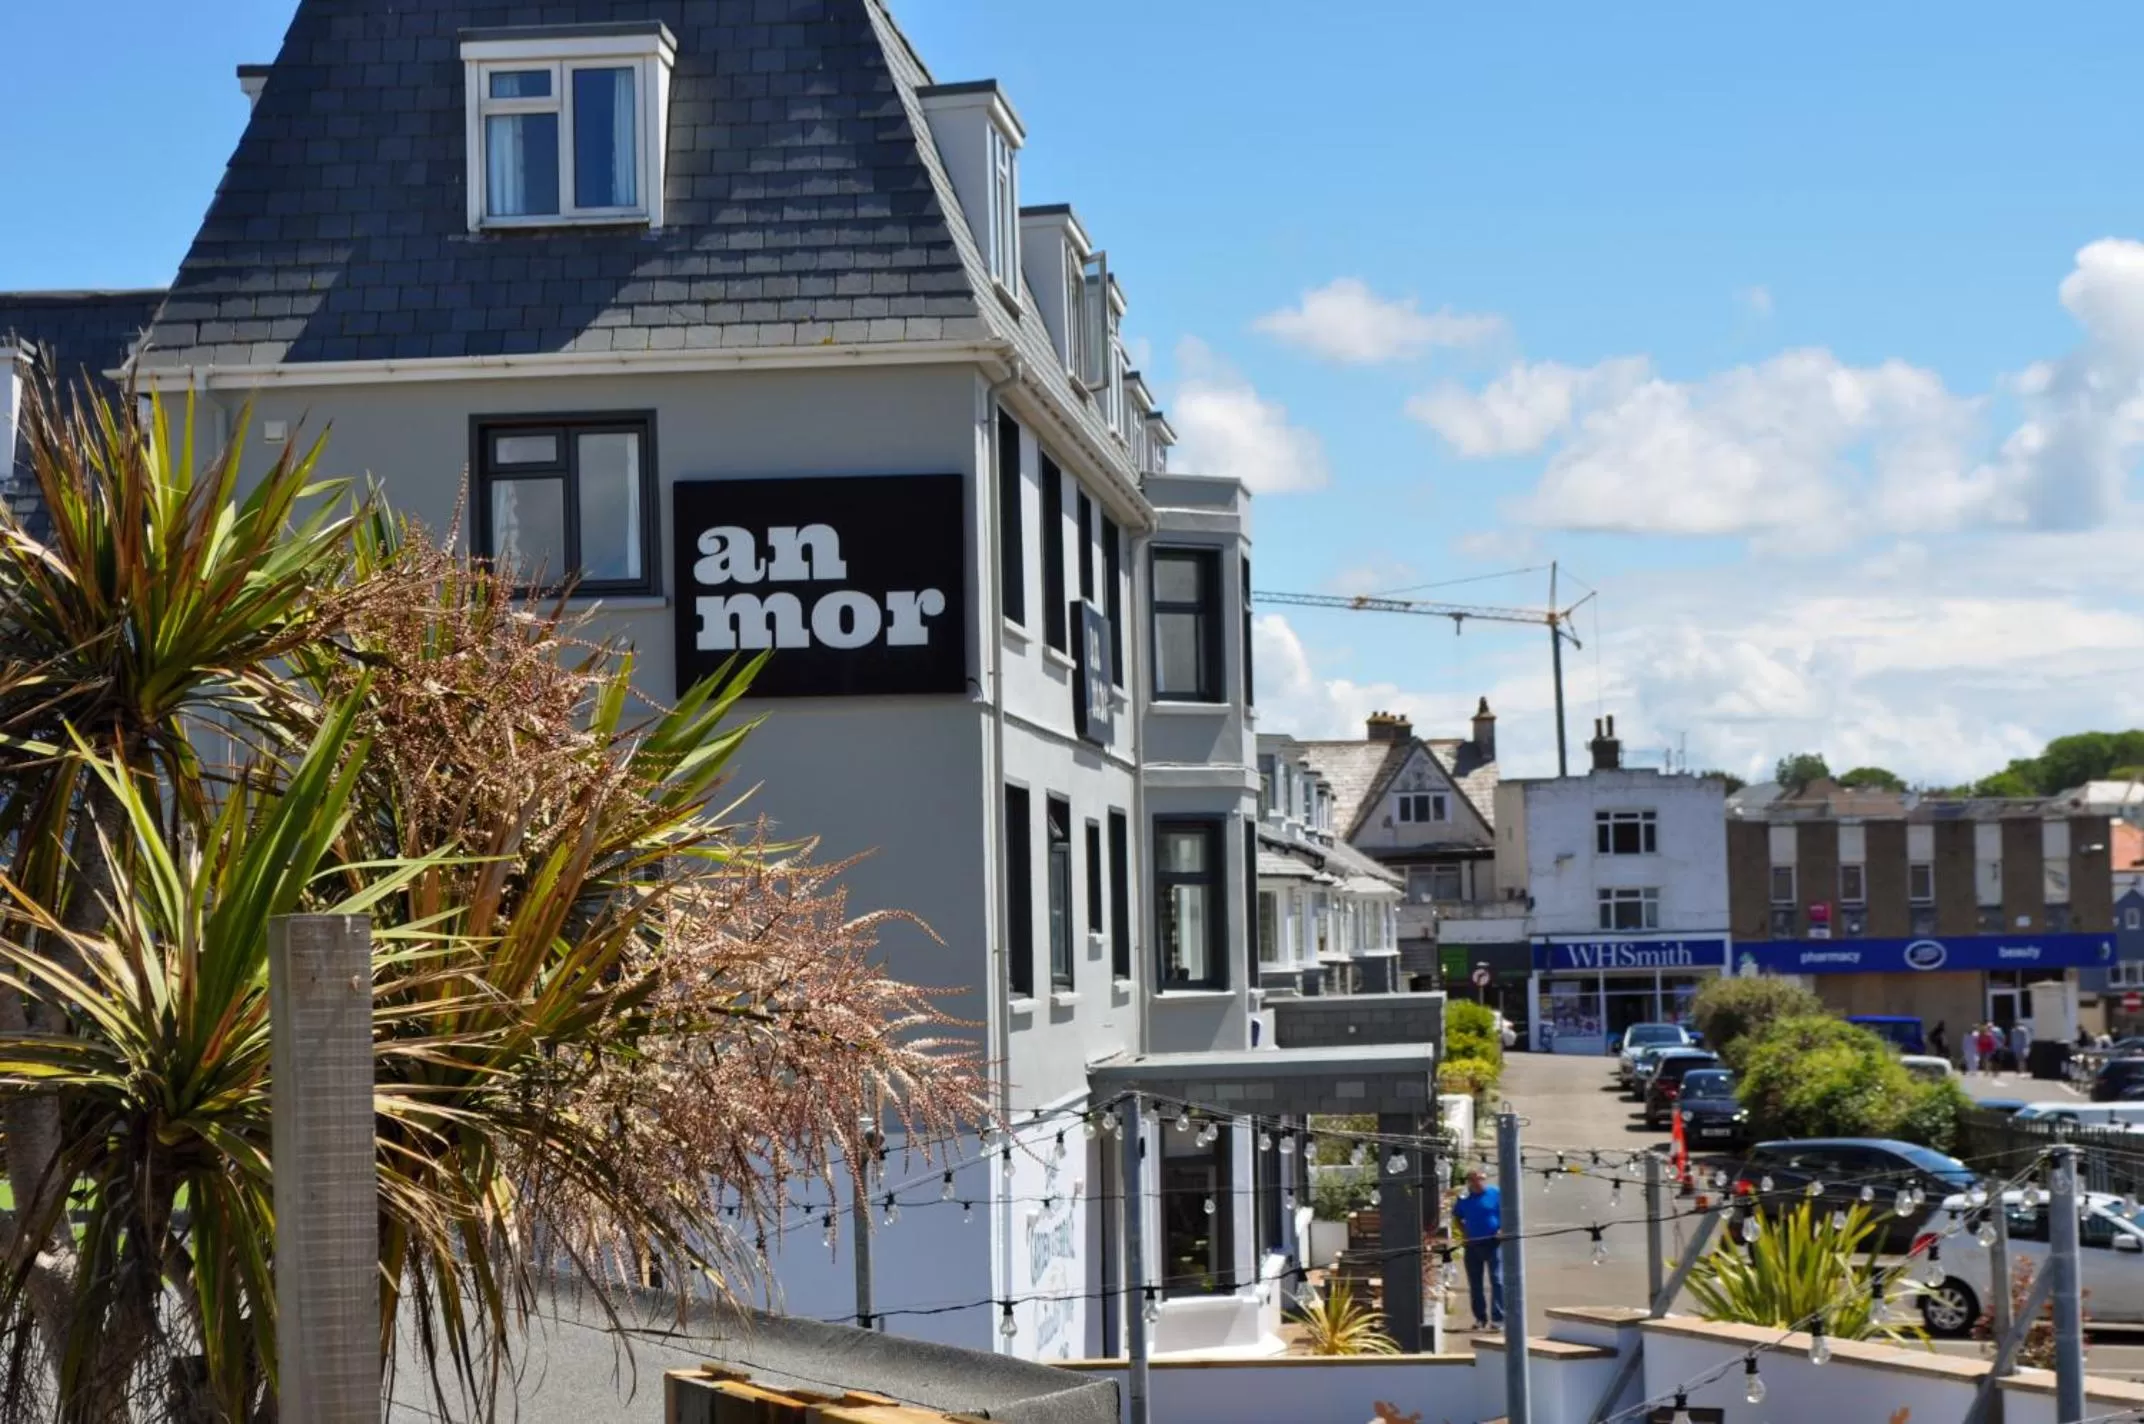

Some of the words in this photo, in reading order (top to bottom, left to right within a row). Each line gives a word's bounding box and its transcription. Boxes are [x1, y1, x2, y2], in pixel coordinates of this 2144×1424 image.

[693, 523, 847, 585] an
[695, 588, 946, 650] mor
[1567, 942, 1693, 967] WHSmith
[1800, 951, 1862, 965] pharmacy
